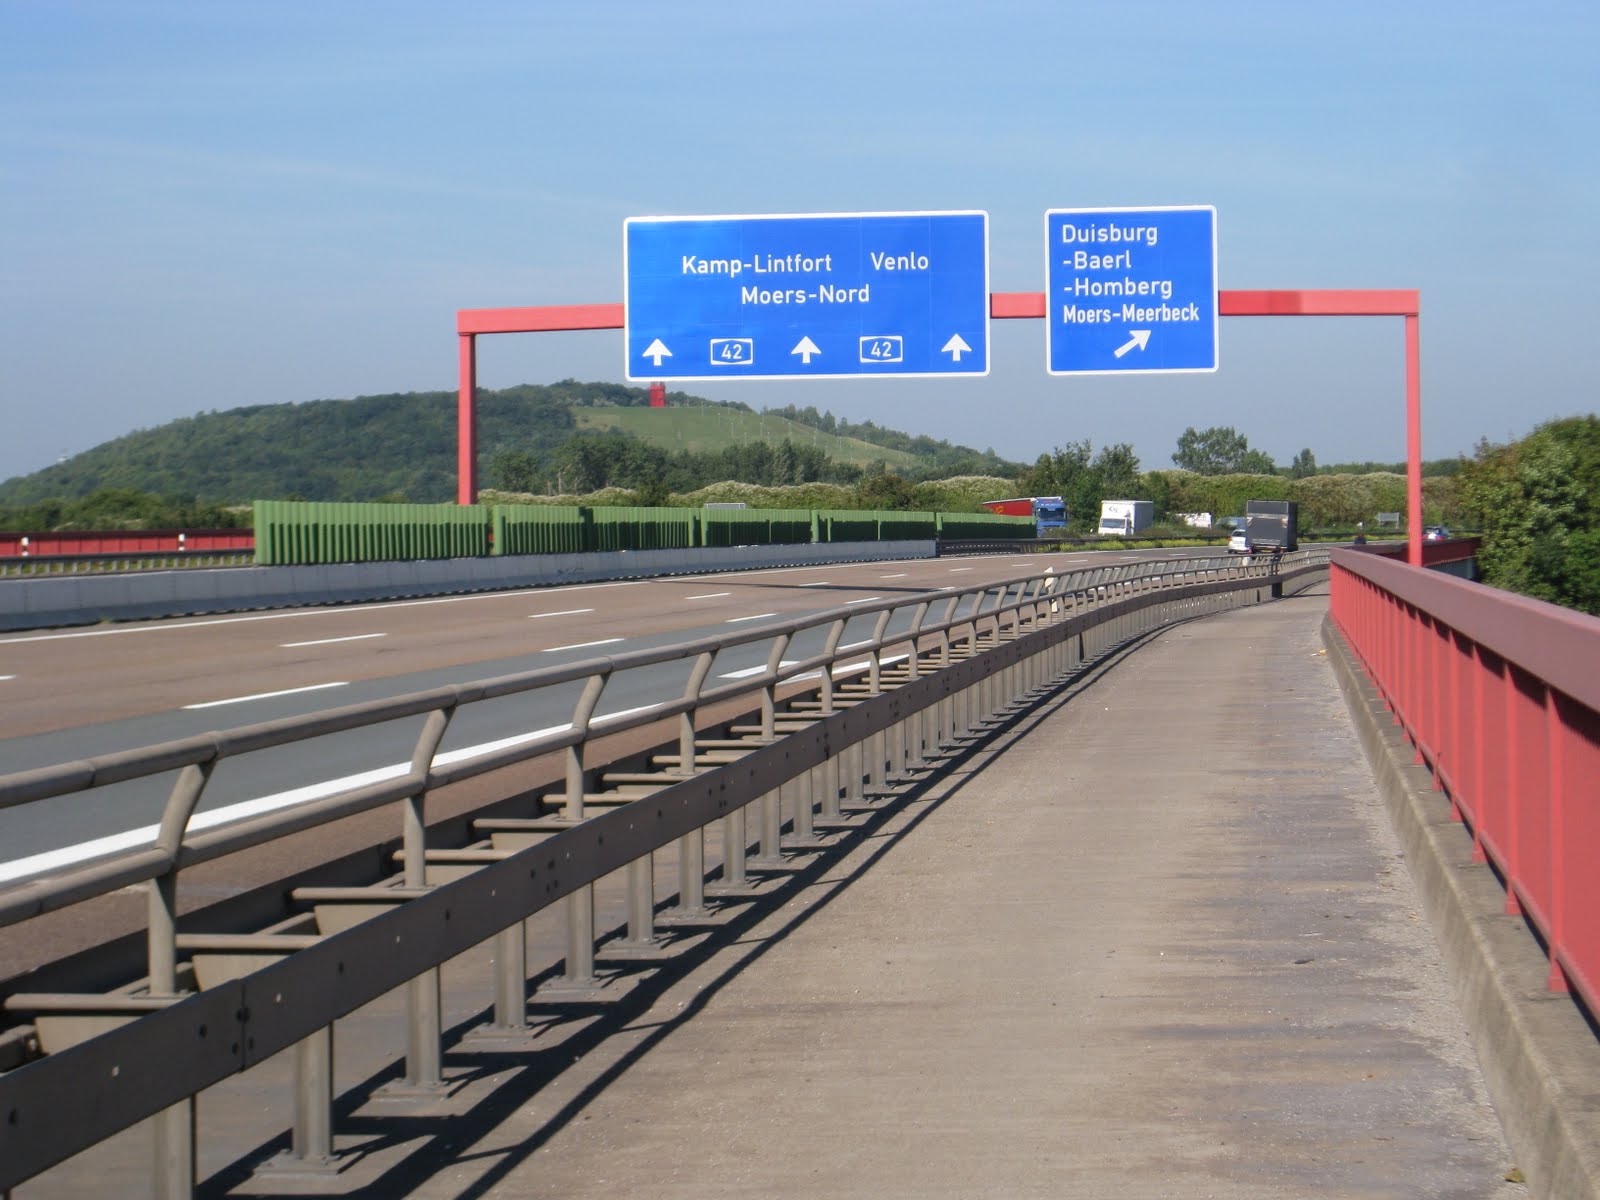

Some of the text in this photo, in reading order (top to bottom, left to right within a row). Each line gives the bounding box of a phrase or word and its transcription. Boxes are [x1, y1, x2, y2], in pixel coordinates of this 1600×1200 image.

[1062, 223, 1158, 246] Duisburg
[681, 252, 929, 278] Kamp-Lintfort Venlo
[1063, 250, 1132, 270] -Baerl
[741, 284, 870, 305] Moers-Nord
[1063, 277, 1173, 300] -Homberg
[1063, 303, 1200, 324] Moers-Meerbeck
[721, 343, 743, 360] 42
[870, 341, 892, 358] 42
